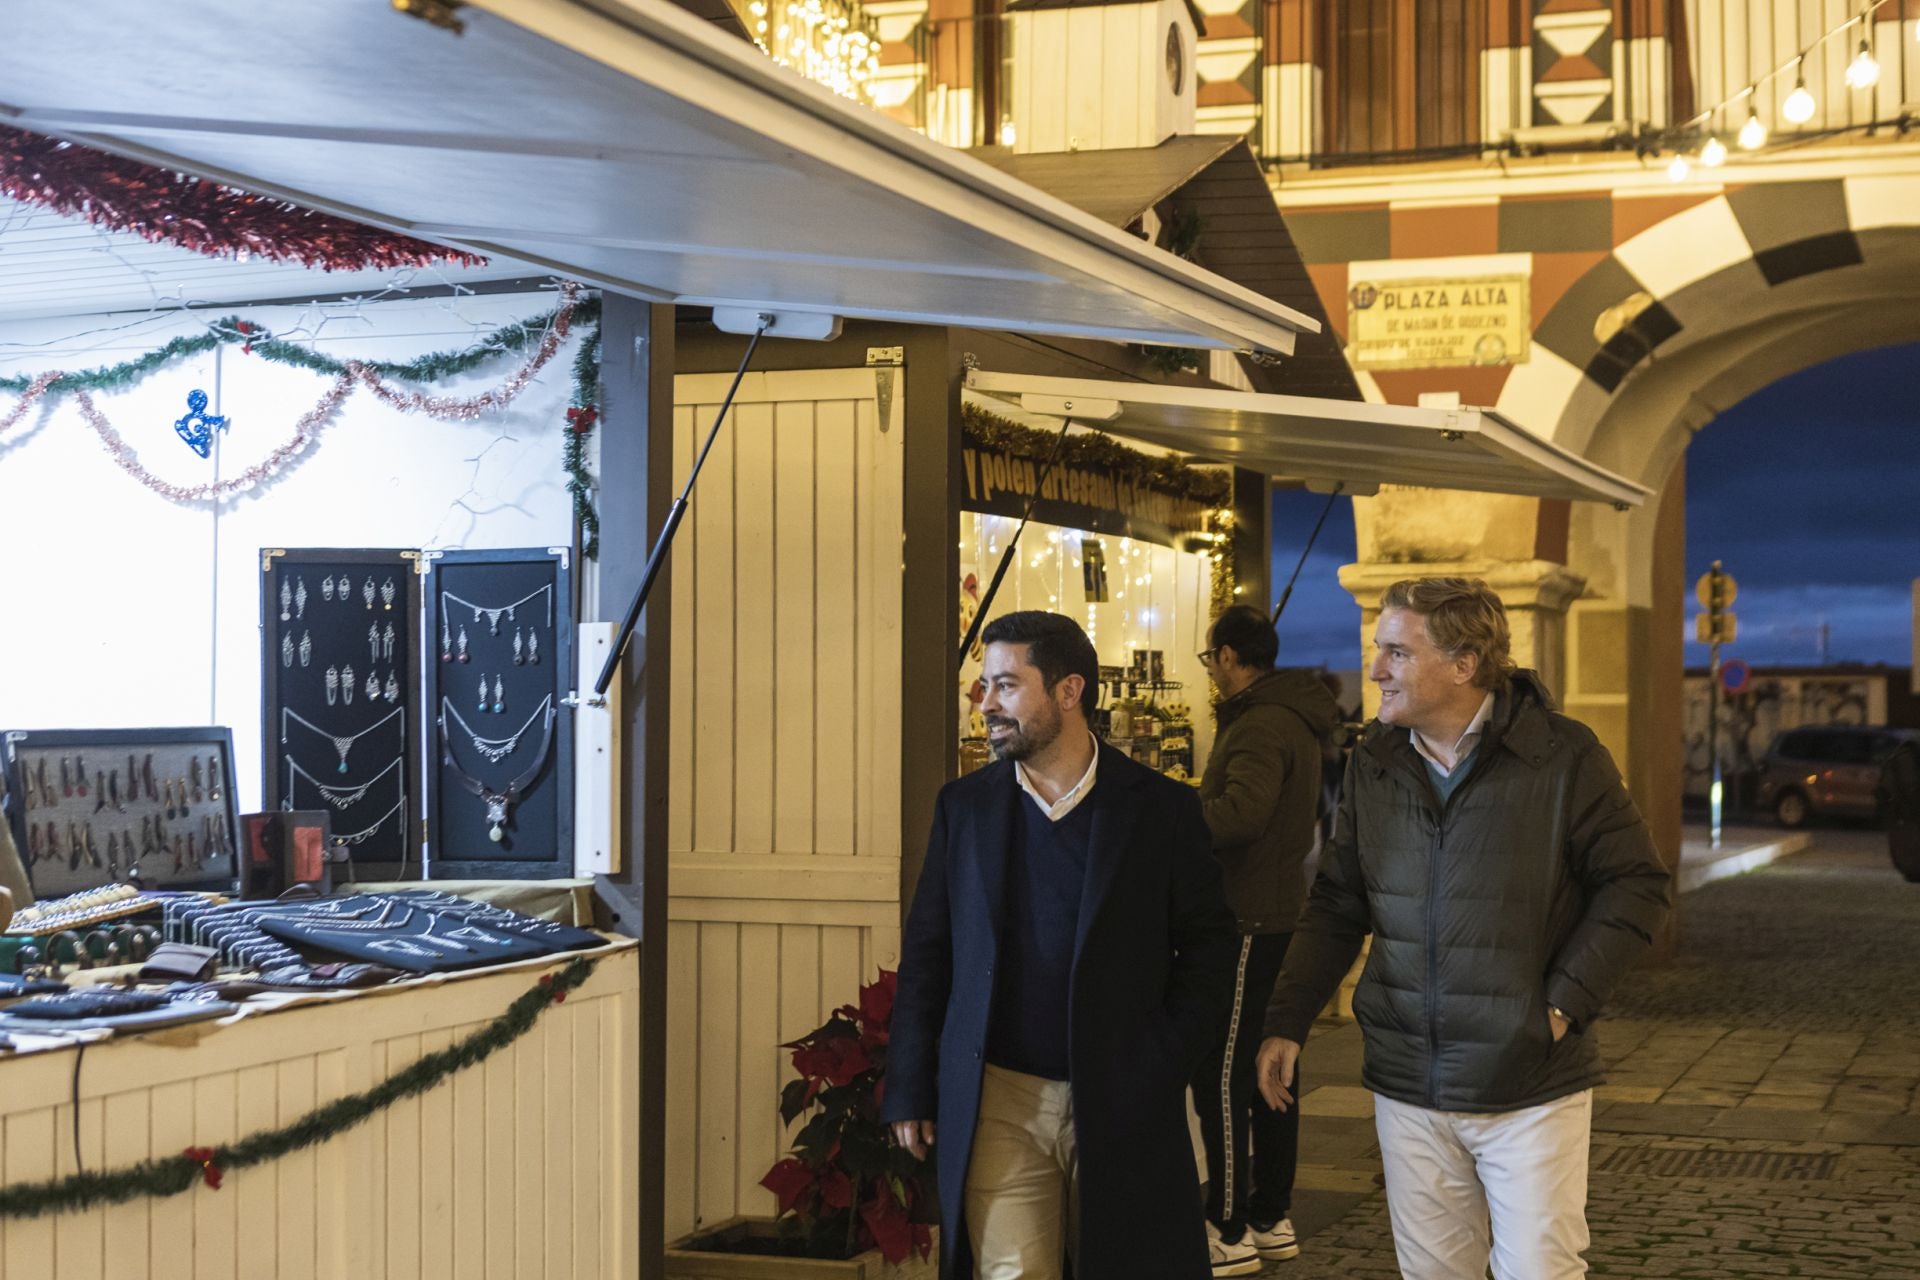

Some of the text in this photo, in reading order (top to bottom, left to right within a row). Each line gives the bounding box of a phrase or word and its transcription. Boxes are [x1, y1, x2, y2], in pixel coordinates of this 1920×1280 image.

[1384, 288, 1507, 310] PLAZA ALTA
[979, 450, 1037, 502] polen
